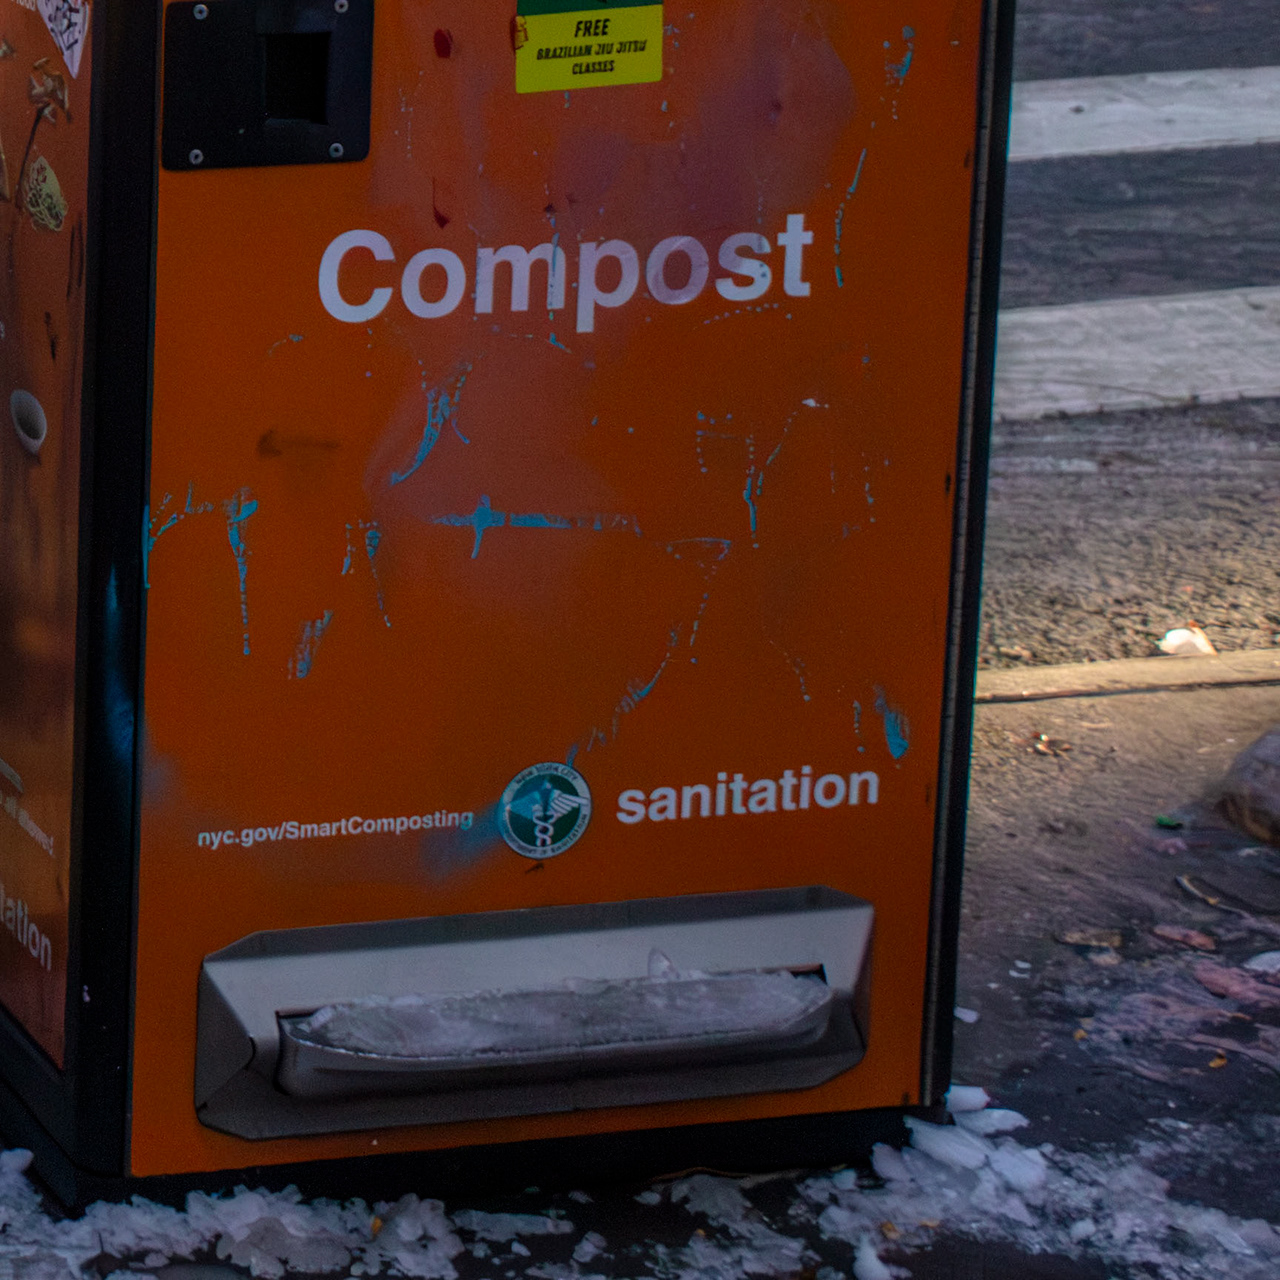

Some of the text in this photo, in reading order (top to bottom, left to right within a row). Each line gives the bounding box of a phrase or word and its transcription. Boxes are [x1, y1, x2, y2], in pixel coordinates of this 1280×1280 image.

[574, 18, 611, 38] FREE
[536, 39, 648, 61] BRAZILIAN JIU JITSU
[572, 60, 616, 75] CLASSES
[317, 213, 814, 333] Compost
[615, 763, 880, 825] sanitation
[197, 809, 474, 850] nyc.gov/SmartComposting
